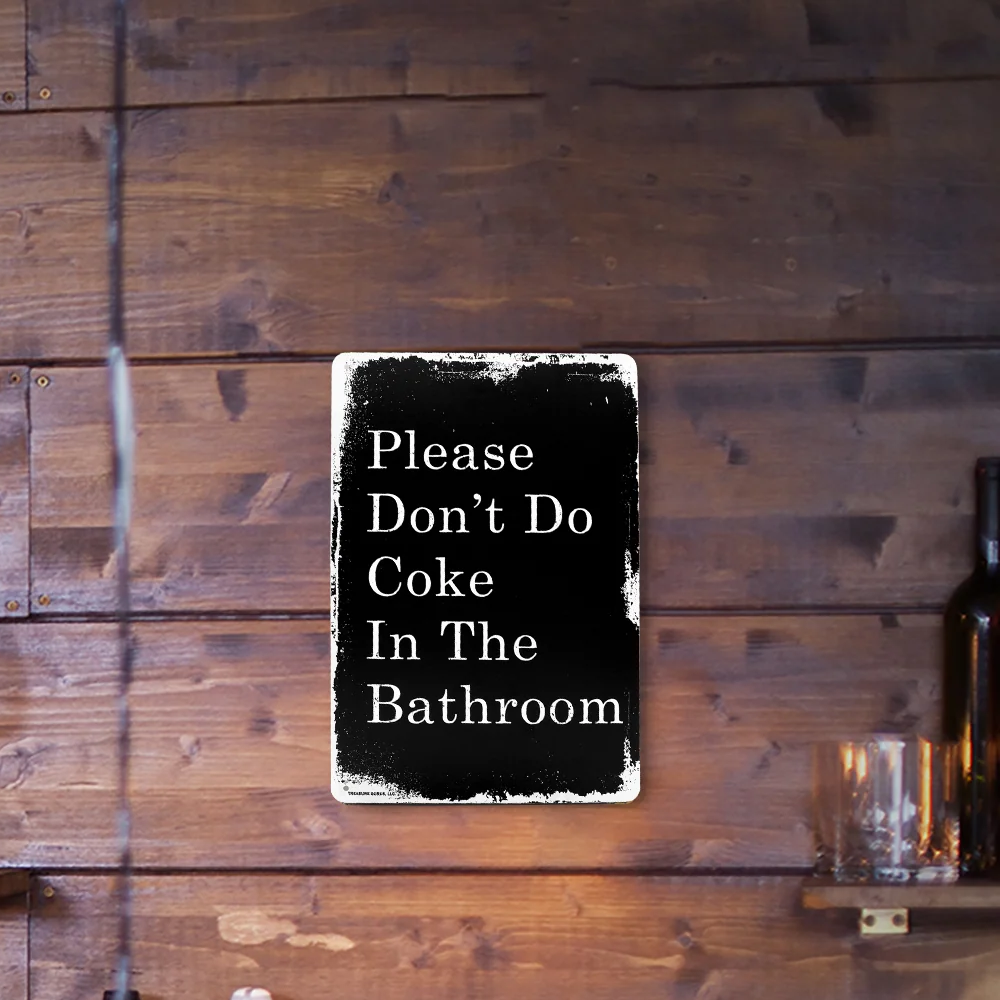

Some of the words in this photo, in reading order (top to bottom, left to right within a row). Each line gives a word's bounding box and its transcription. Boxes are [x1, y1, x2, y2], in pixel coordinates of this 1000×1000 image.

[367, 429, 534, 471] Please
[366, 492, 505, 534] Don’t
[525, 493, 593, 535] Do
[368, 555, 494, 598] Coke
[366, 619, 421, 660] In
[441, 620, 538, 662] The
[366, 683, 624, 725] Bathroom
